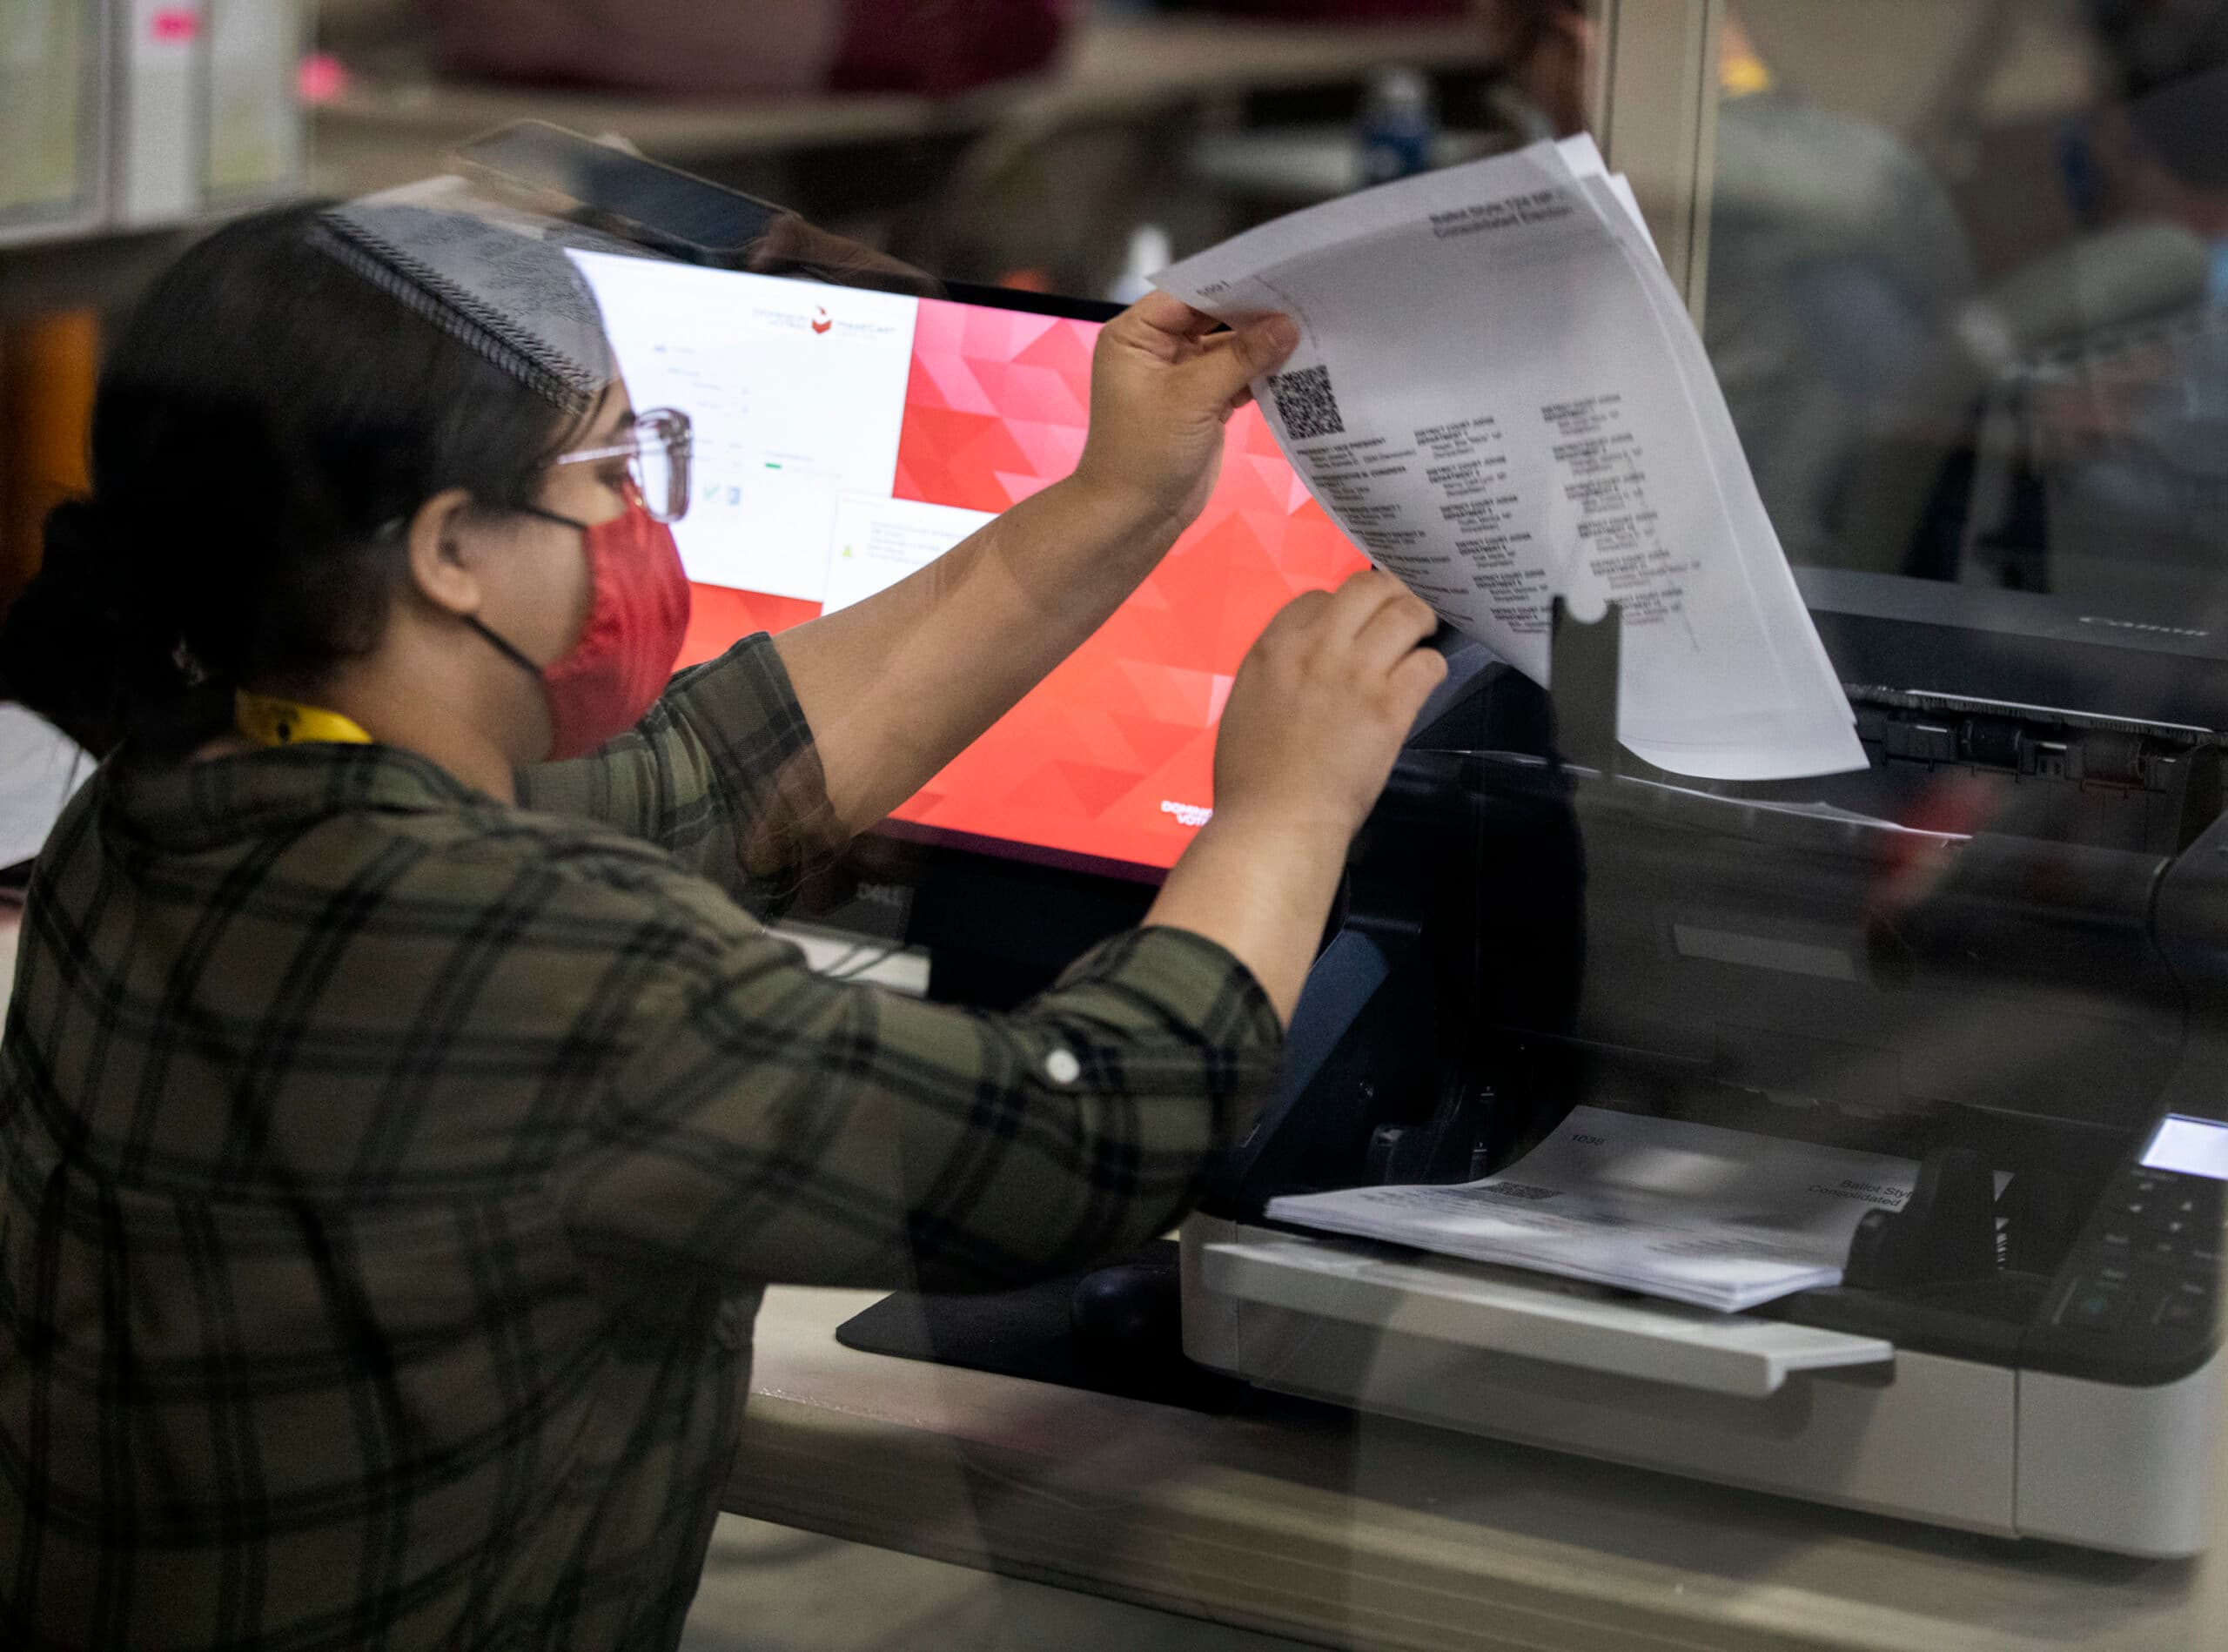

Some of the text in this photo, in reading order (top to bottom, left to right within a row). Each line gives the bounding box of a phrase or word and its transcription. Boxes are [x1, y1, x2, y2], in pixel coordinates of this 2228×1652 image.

[1160, 800, 1213, 818] DOMINI
[1808, 1184, 1902, 1206] Consolidated
[1883, 1186, 1915, 1199] Styl
